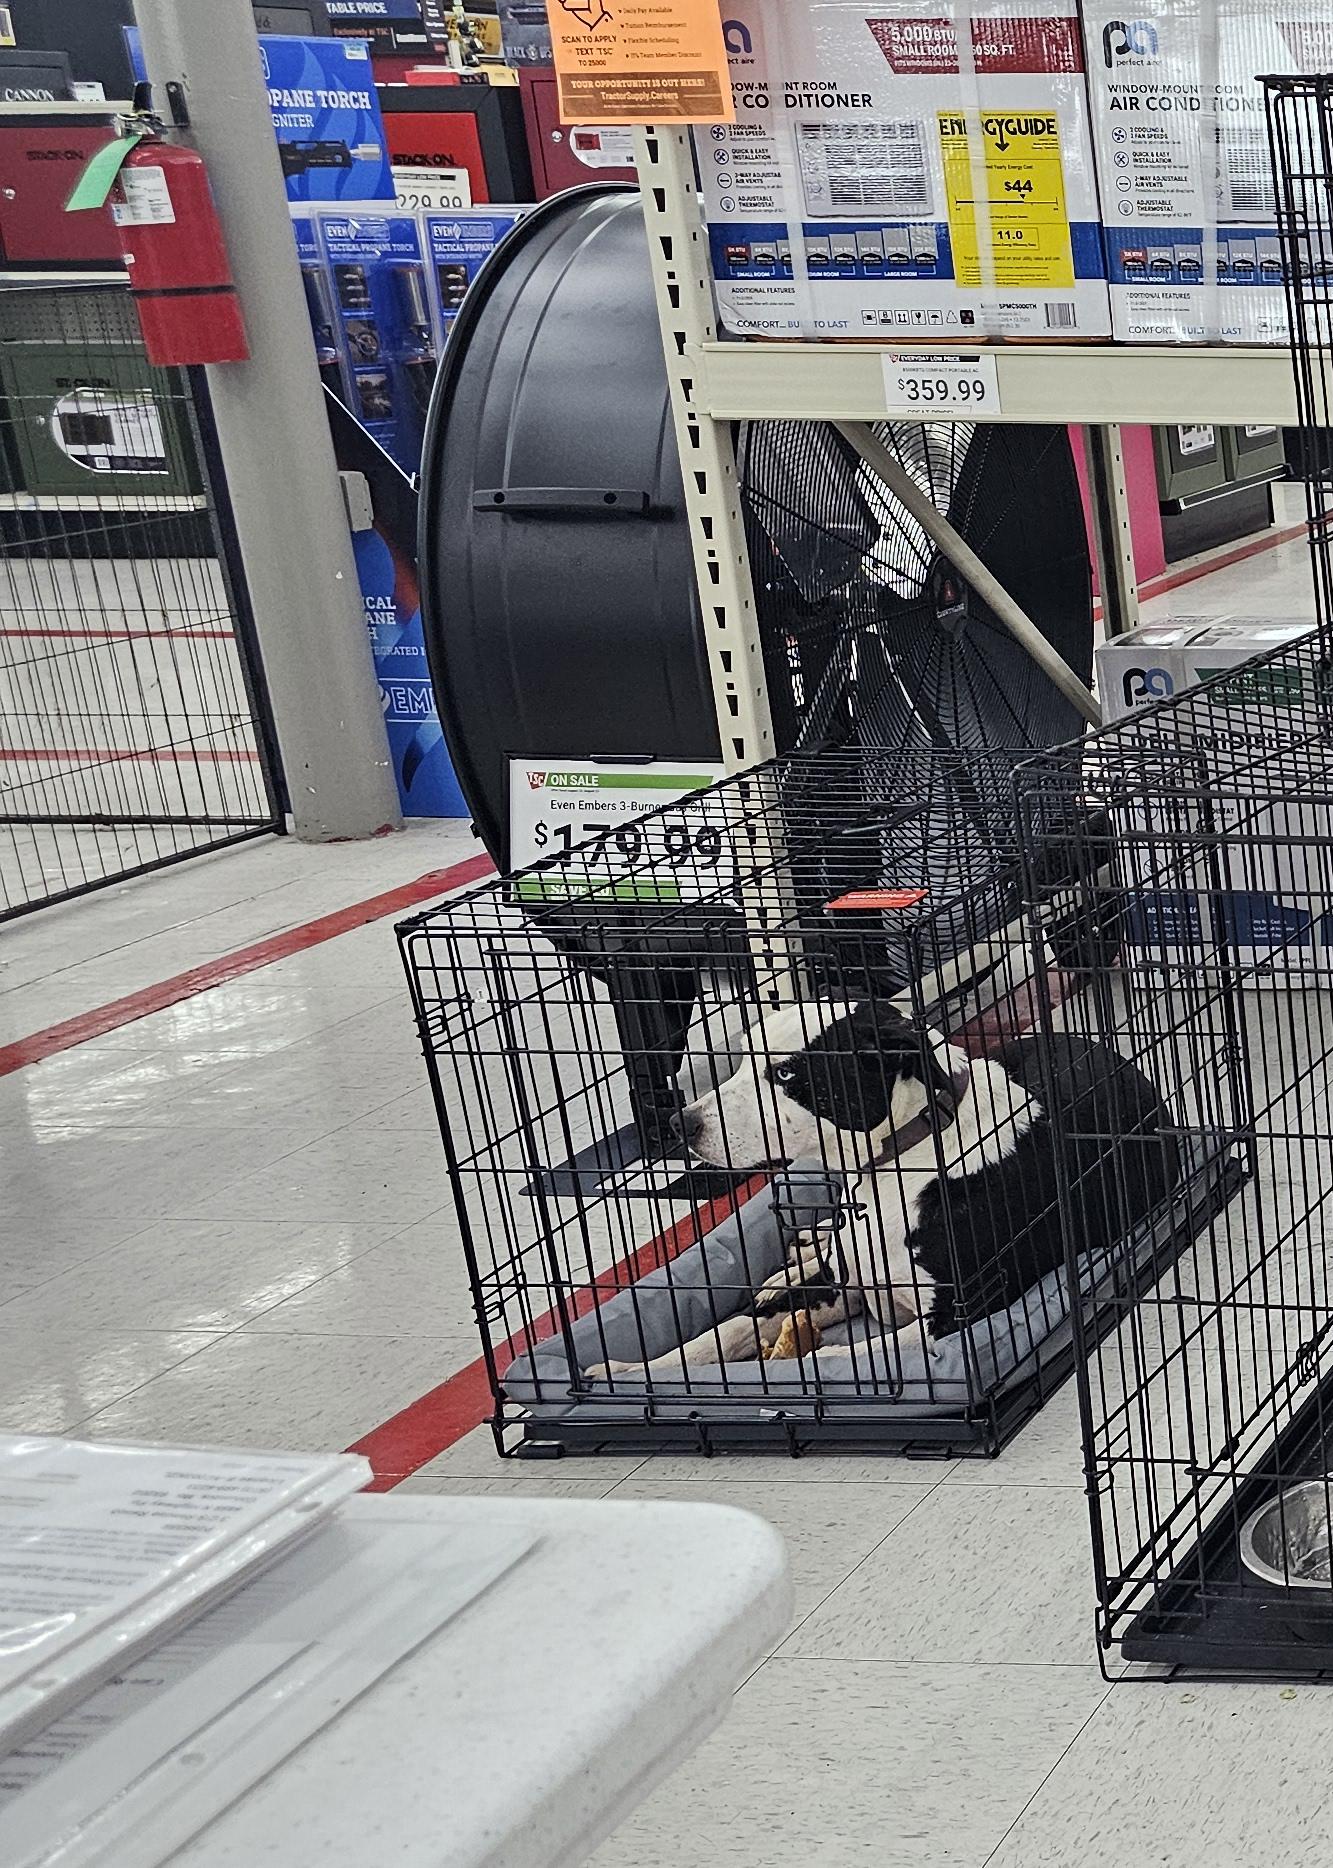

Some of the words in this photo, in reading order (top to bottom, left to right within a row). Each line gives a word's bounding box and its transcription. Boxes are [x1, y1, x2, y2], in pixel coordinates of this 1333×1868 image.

[357, 2, 387, 14] PRICE
[561, 36, 581, 44] SCAN
[594, 35, 617, 43] APPLY
[576, 48, 593, 56] TEXT
[893, 45, 927, 56] SMALL
[1116, 59, 1144, 67] perfect
[571, 80, 593, 89] YOUR
[595, 80, 651, 88] OPPORTUNITY
[652, 79, 660, 87] IS
[661, 79, 679, 87] OUT
[802, 82, 837, 90] ROOM
[5, 88, 55, 101] CANNON
[315, 90, 371, 109] TORCH
[601, 92, 679, 101] TractorSupply.Careers
[1109, 97, 1140, 110] AIR
[1004, 180, 1033, 192] $44
[997, 231, 1023, 240] 11.0
[1221, 327, 1241, 335] LAST
[898, 379, 985, 401] $359.99
[551, 774, 567, 786] ON
[570, 775, 599, 786] SALE
[551, 800, 575, 811] Even
[579, 800, 616, 811] Embers
